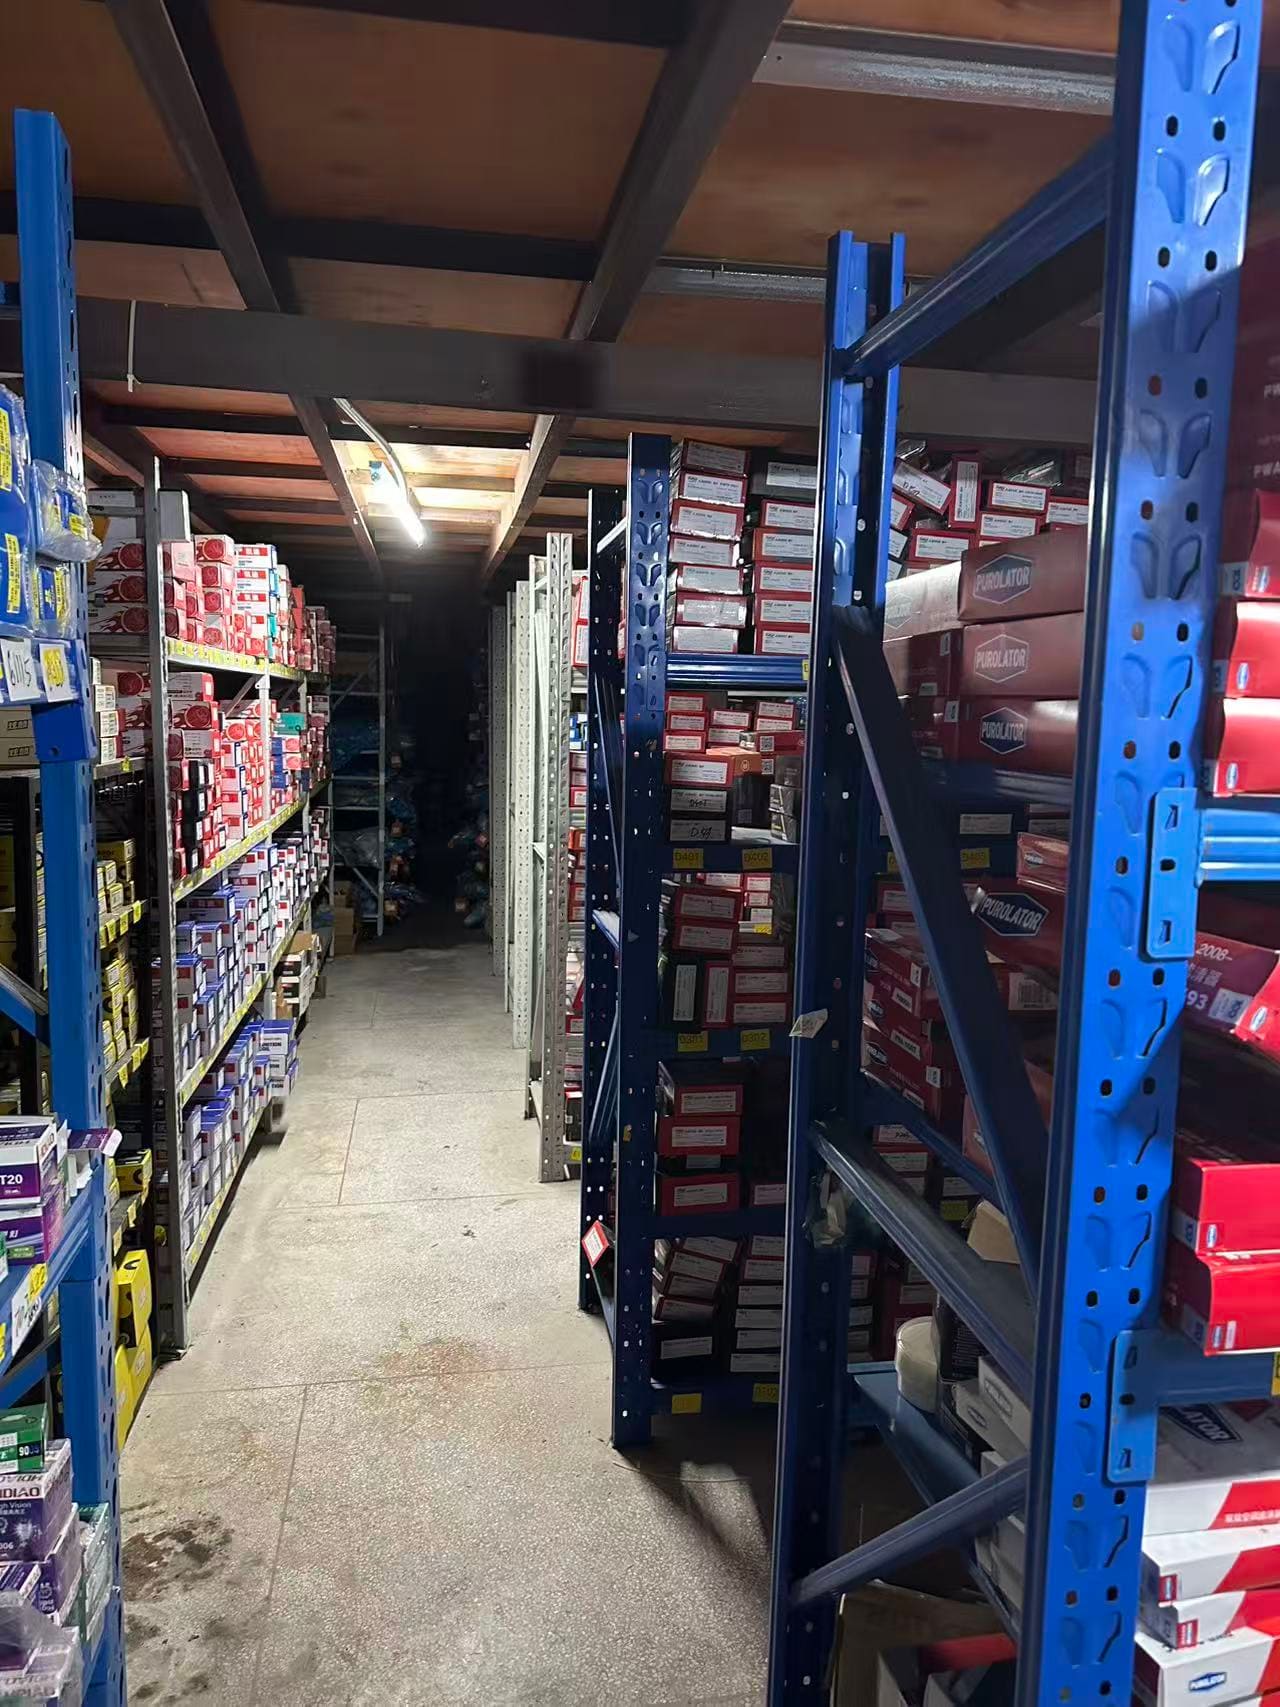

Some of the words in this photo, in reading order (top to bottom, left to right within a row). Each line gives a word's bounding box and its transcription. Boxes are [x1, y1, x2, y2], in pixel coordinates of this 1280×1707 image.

[975, 565, 1031, 594] PUROLATOR
[975, 648, 1026, 669] PUROLATOR
[981, 719, 1025, 743] PUROLATOR
[981, 898, 1043, 930] PUROLATOR
